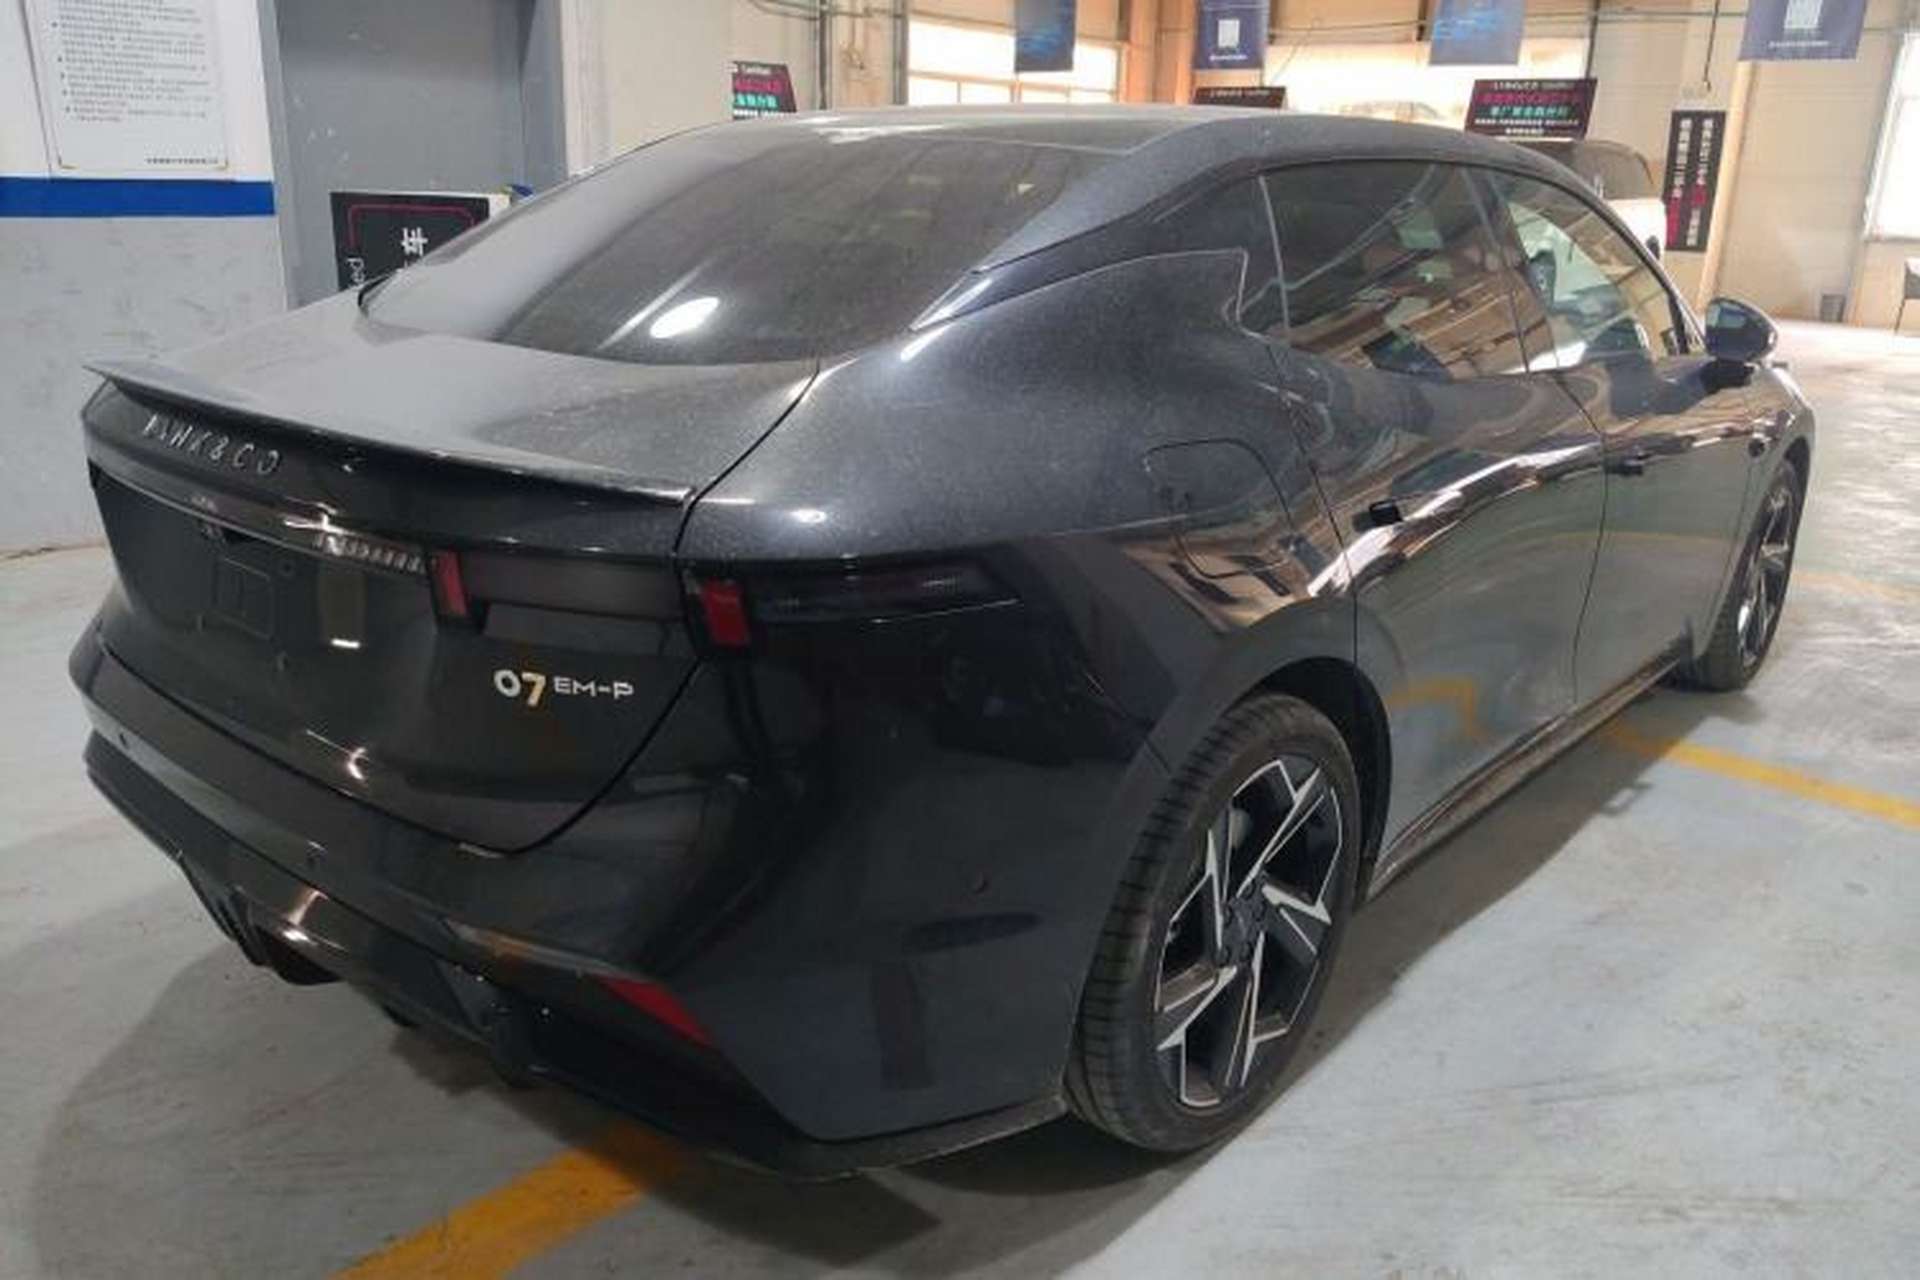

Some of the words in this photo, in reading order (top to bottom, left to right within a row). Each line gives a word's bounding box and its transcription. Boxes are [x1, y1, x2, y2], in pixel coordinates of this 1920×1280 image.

[401, 226, 428, 267] 车
[347, 256, 365, 285] ed
[493, 668, 547, 708] 07
[553, 675, 635, 700] EM-P
